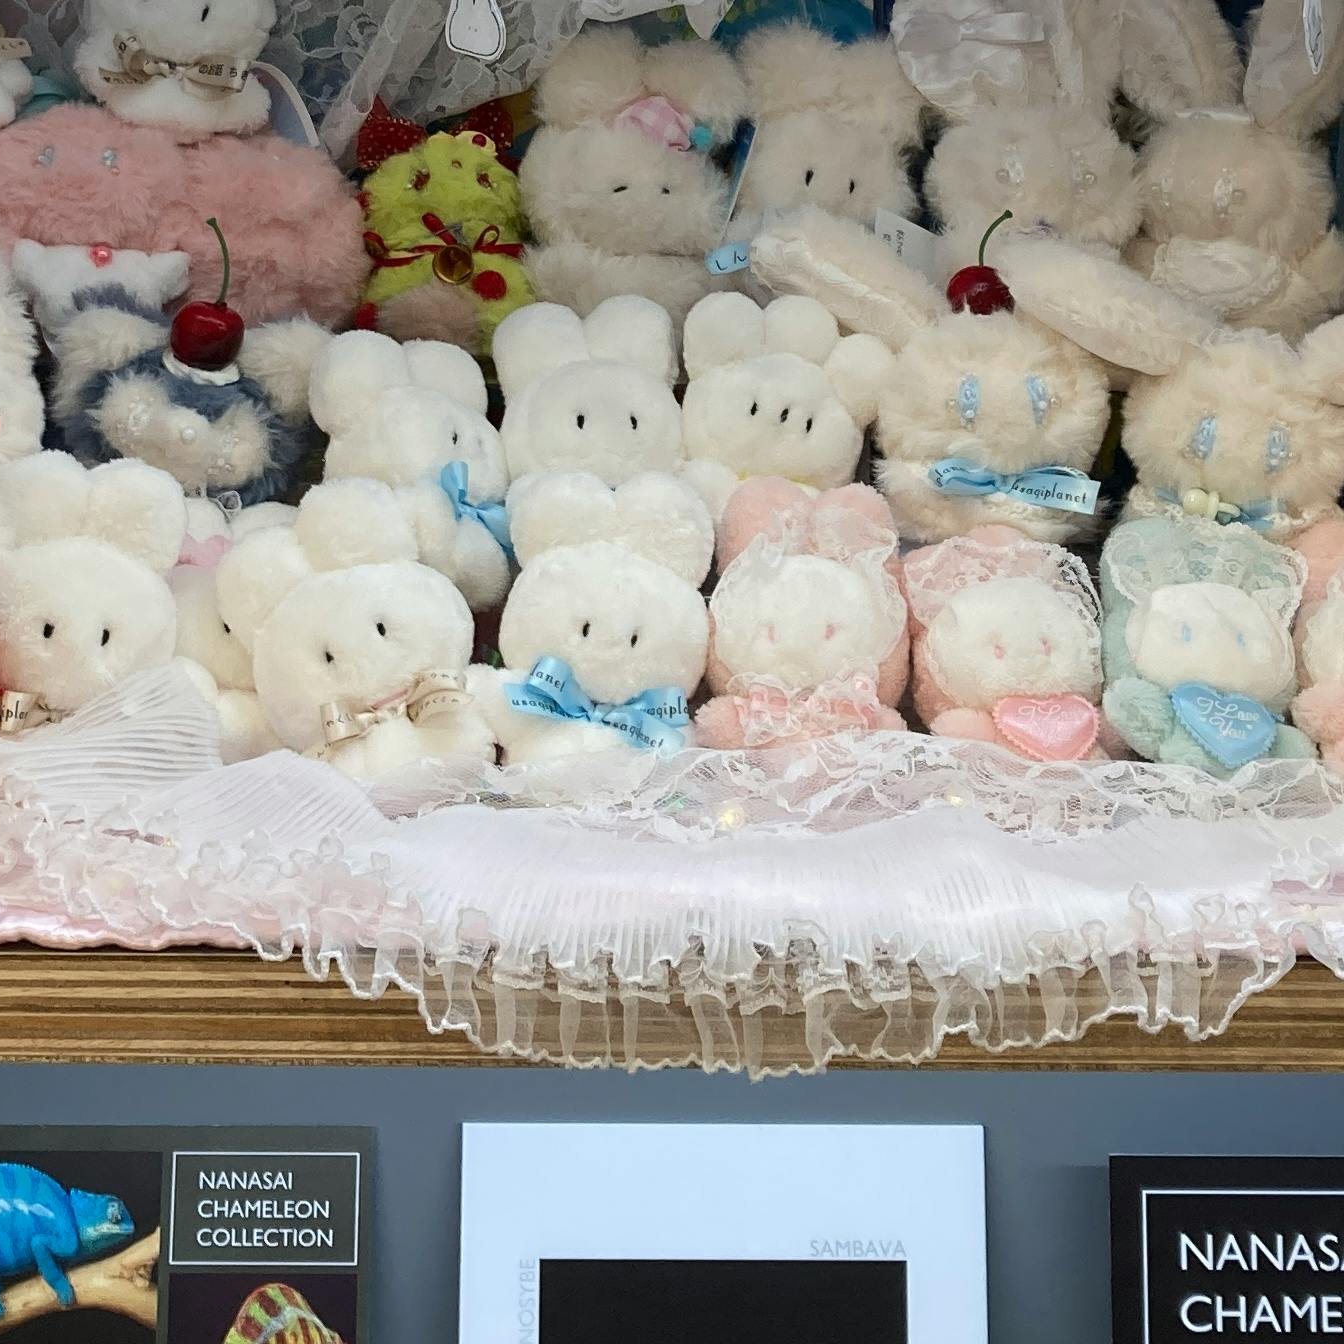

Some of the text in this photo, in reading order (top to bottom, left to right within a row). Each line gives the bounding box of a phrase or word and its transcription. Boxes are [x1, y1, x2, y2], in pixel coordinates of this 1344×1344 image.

[198, 1170, 293, 1191] NANASAI
[197, 1199, 330, 1219] CHAMELEON
[196, 1228, 334, 1248] COLLECTION
[809, 1239, 907, 1258] SAMBAVA
